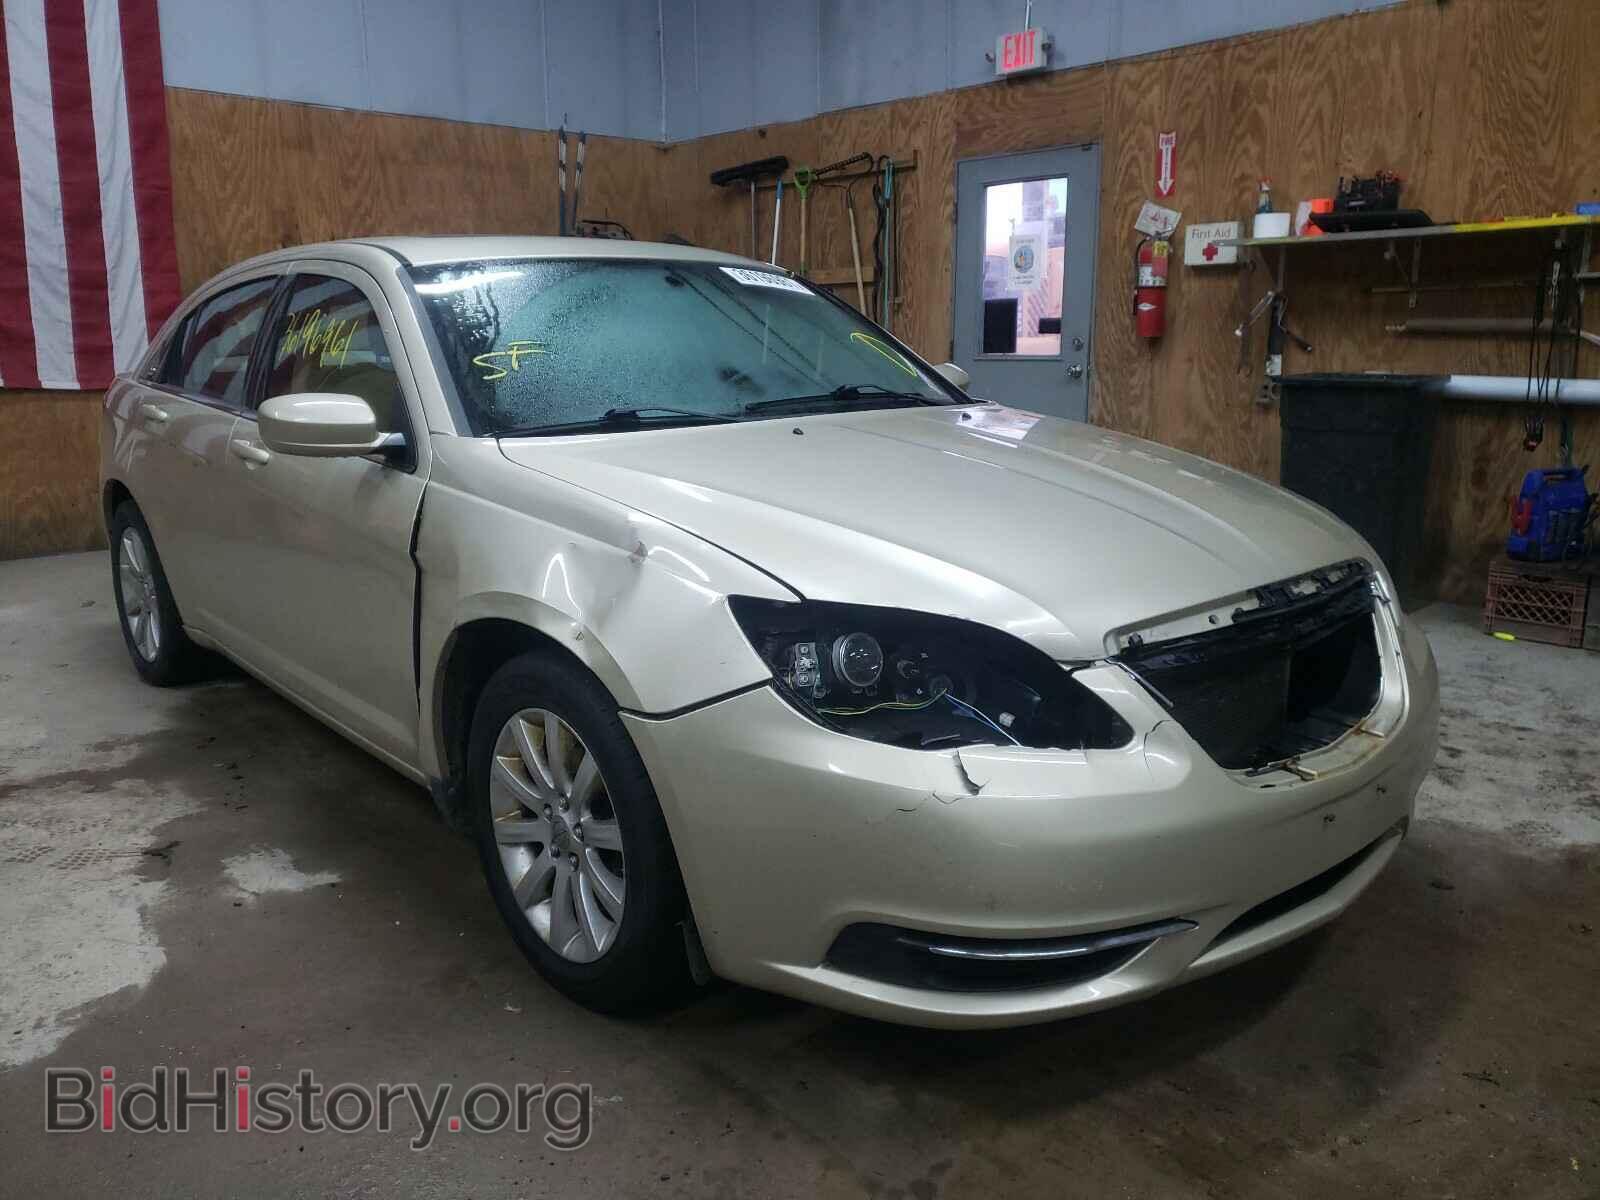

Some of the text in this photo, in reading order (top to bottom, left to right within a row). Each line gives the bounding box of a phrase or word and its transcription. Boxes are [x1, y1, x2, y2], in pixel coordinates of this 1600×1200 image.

[1003, 33, 1035, 68] EXIT
[1191, 227, 1232, 240] First Aid
[472, 340, 551, 380] SF
